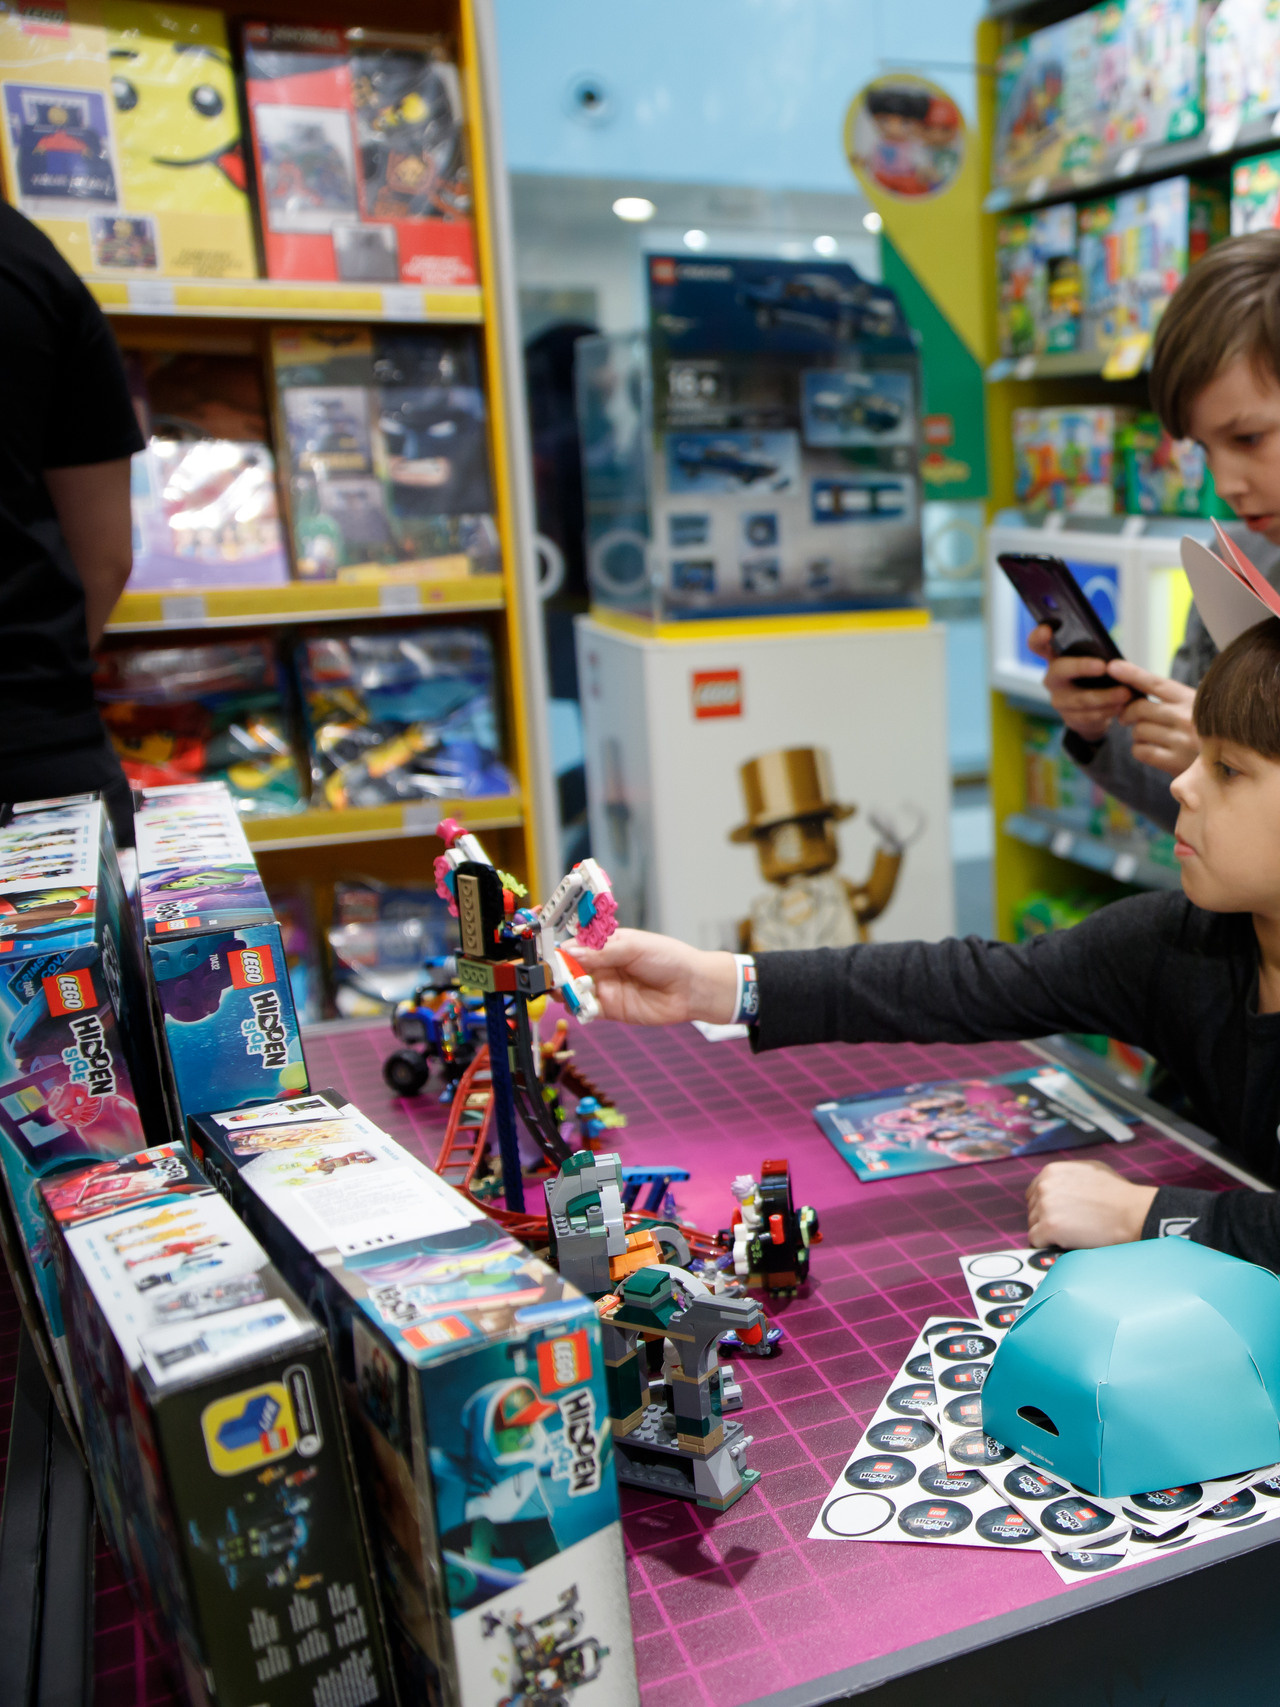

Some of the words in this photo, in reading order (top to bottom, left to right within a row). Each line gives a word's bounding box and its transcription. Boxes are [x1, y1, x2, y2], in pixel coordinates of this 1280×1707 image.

[209, 953, 221, 971] 70432
[241, 951, 263, 984] LEGO
[56, 975, 83, 1010] LEGO
[243, 1021, 265, 1054] SIDE
[252, 991, 287, 1068] HIDDEN
[64, 1047, 90, 1083] SIDE
[72, 1016, 115, 1096] HIDDEN
[552, 1339, 577, 1386] LEGO
[563, 1392, 597, 1491] HIDDEN
[860, 1472, 896, 1480] HIDDEN
[934, 1479, 970, 1488] HIDDEN
[914, 1518, 951, 1528] HIDDEN
[992, 1525, 1030, 1534] HIDDEN
